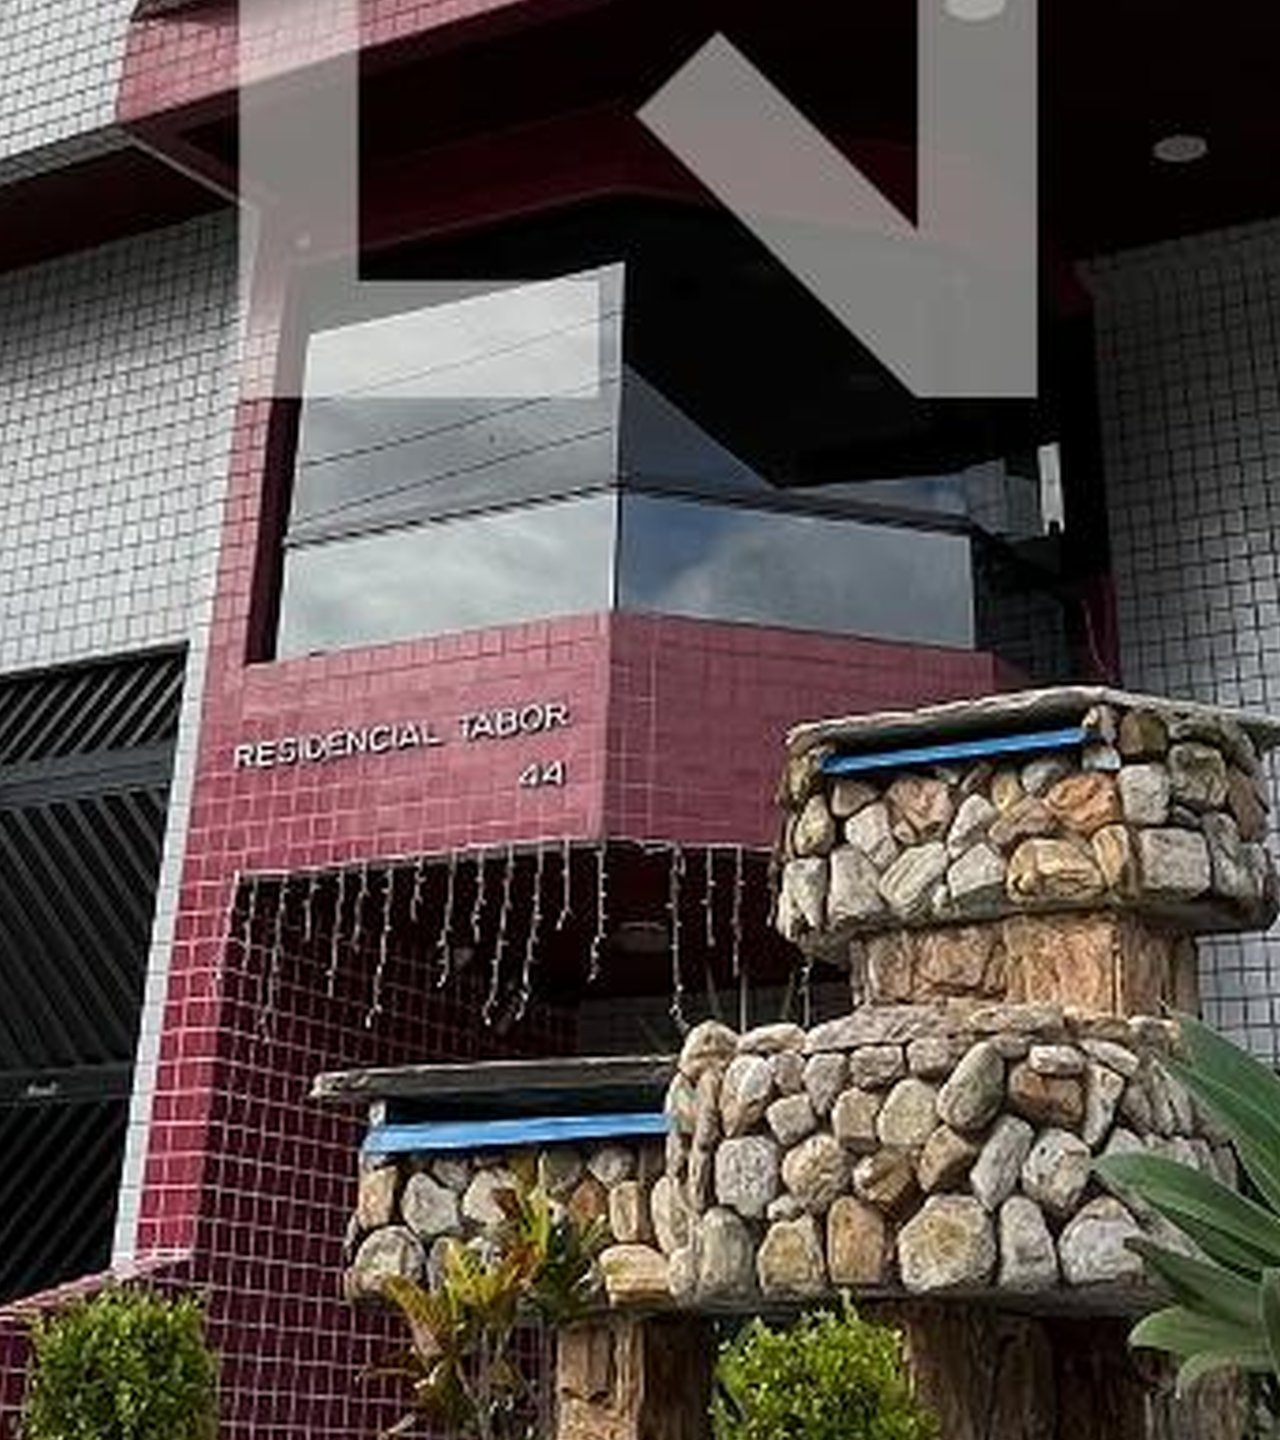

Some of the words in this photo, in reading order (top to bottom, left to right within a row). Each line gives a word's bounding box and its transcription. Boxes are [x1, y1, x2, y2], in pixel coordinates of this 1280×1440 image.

[232, 720, 441, 770] RESIDENCIAL
[460, 703, 569, 740] TABOR
[519, 760, 566, 788] 44
